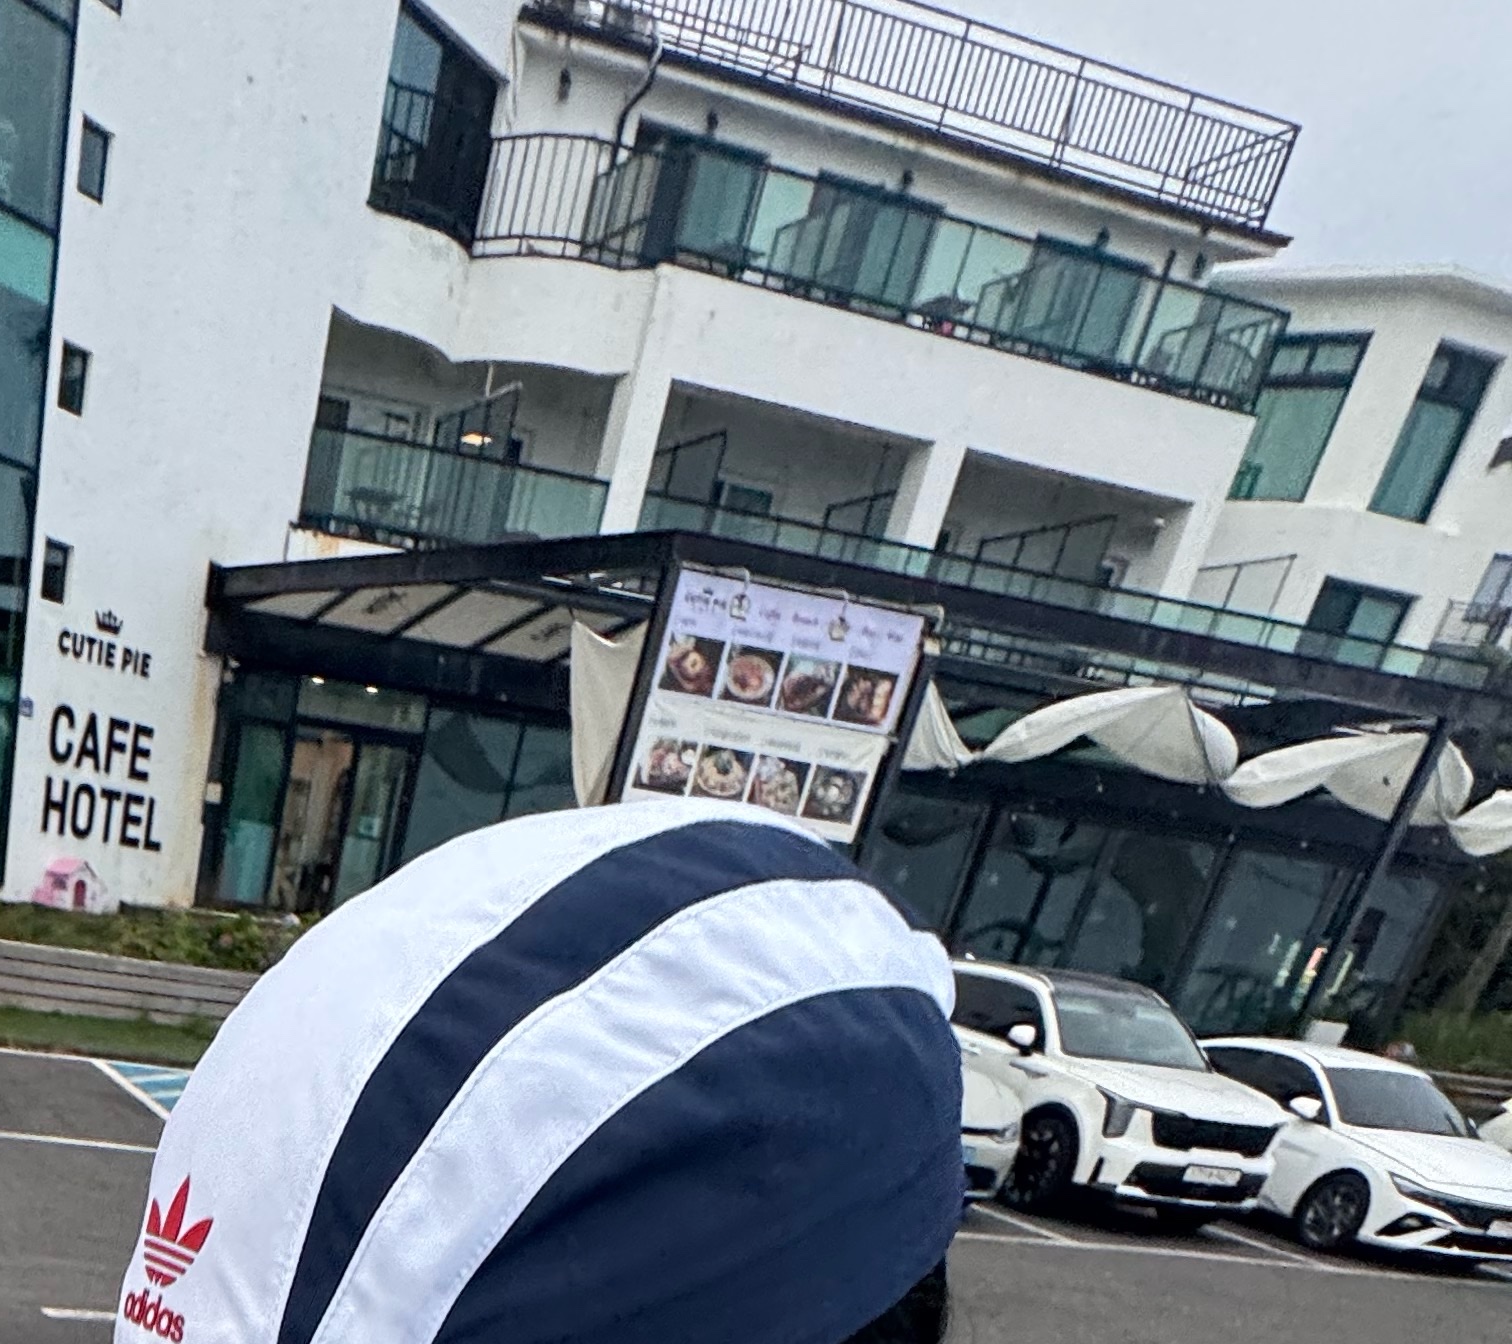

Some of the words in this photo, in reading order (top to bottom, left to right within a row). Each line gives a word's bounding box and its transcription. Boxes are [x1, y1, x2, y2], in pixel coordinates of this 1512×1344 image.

[57, 629, 116, 669] CUTIE
[122, 646, 153, 678] PIE
[49, 704, 154, 782] CAFE
[42, 777, 163, 853] HOTEL
[123, 1286, 186, 1344] adidas
